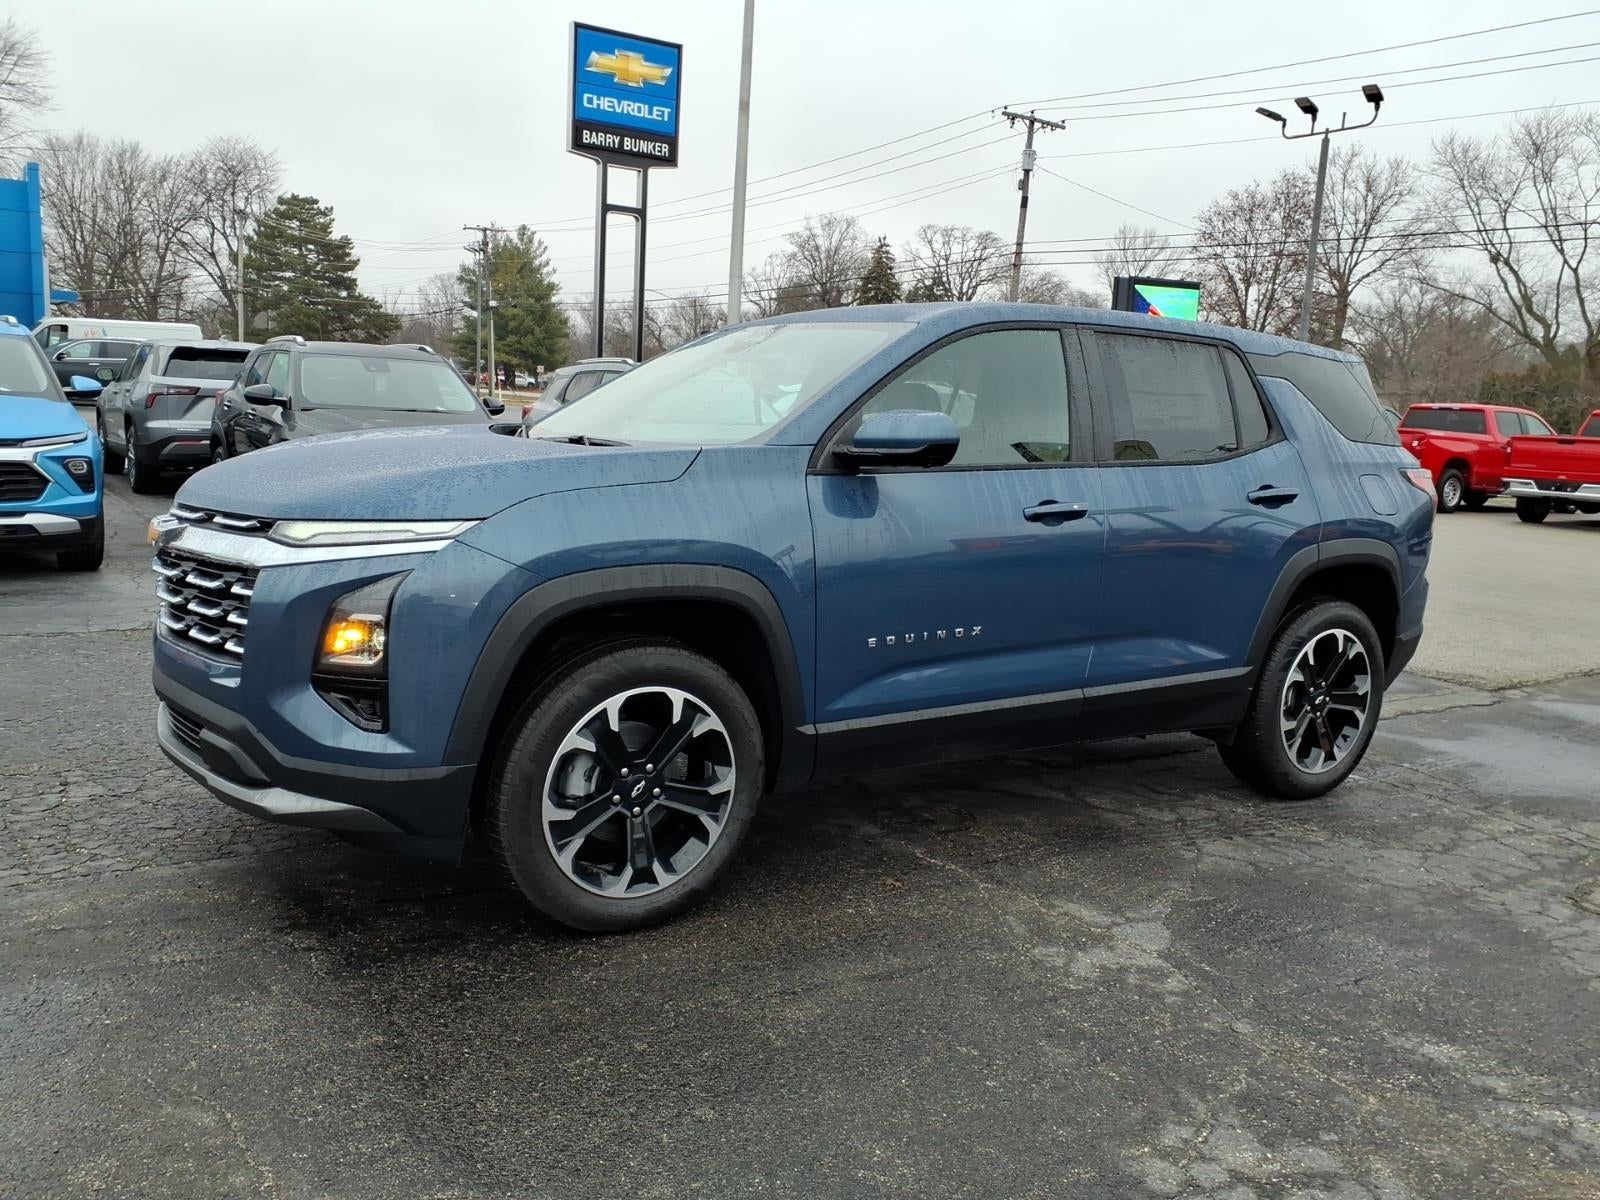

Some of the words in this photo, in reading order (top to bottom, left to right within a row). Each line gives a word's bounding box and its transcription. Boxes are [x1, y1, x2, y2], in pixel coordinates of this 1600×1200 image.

[582, 93, 671, 121] CHEVROLET
[582, 129, 620, 148] BARRY
[623, 137, 669, 157] BUNKER
[868, 626, 982, 647] EQUINOX
